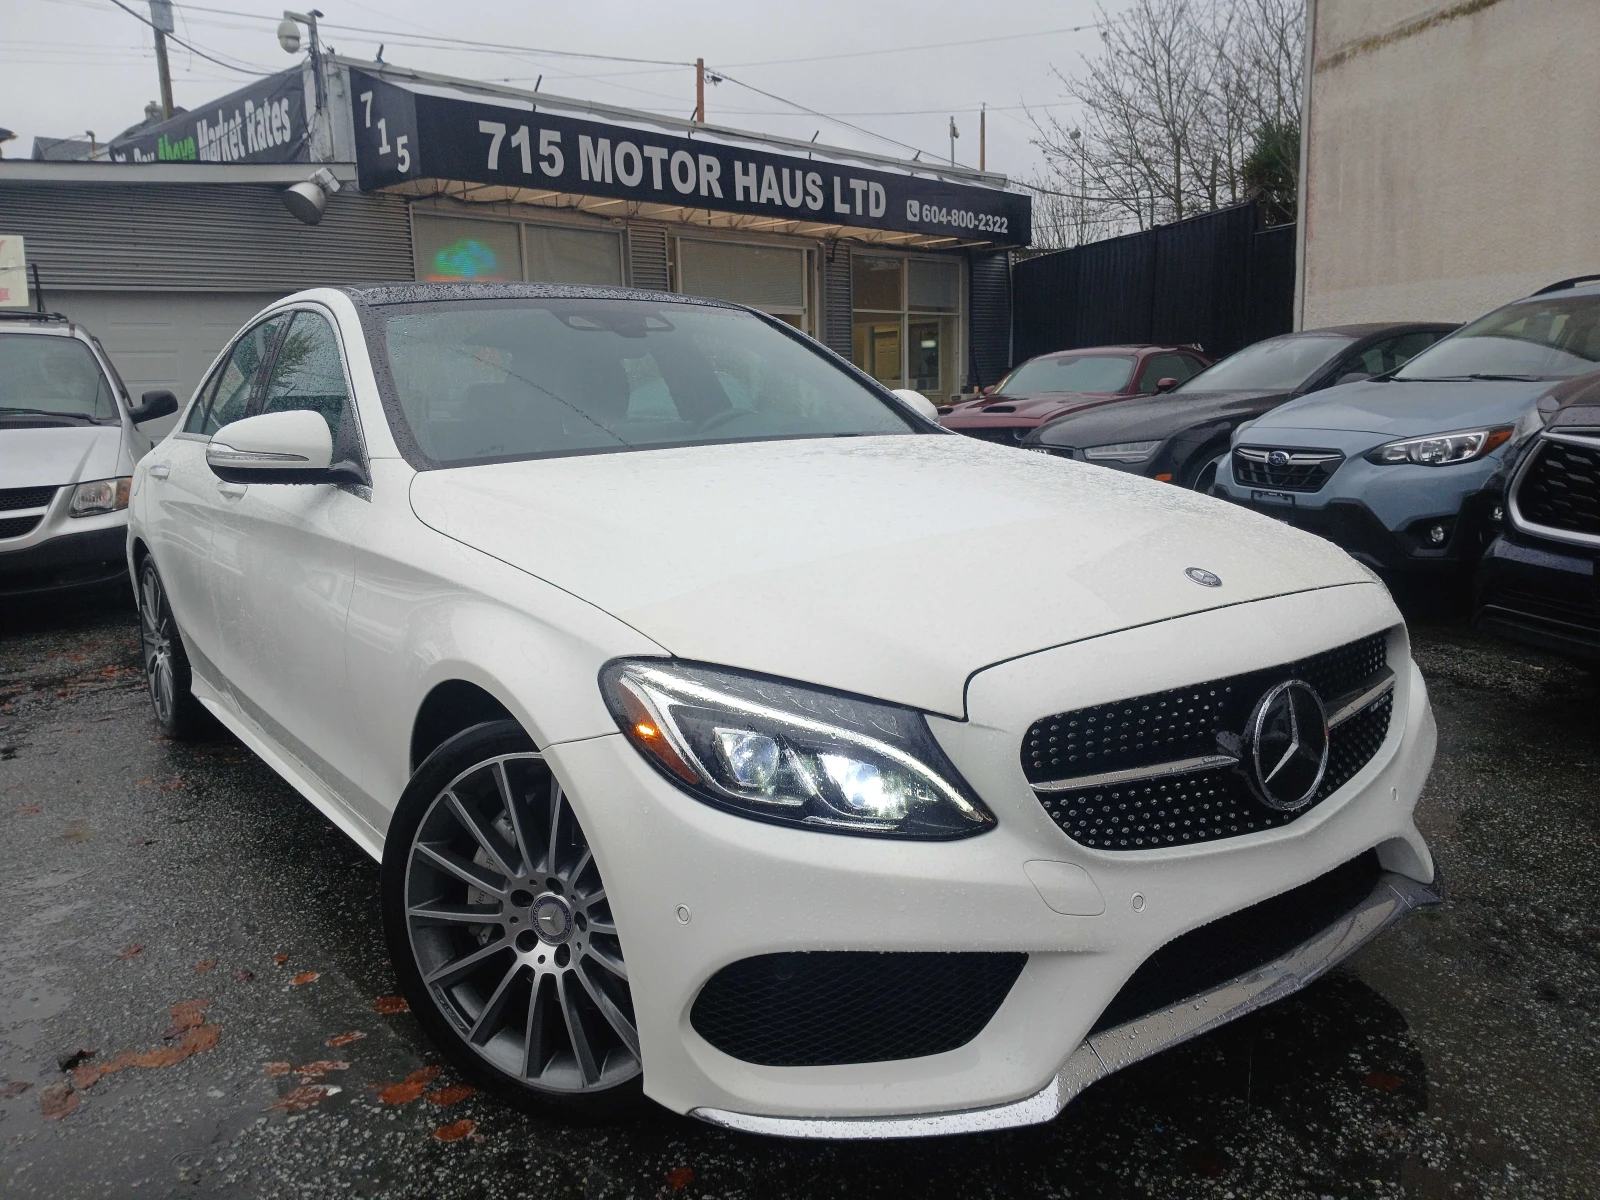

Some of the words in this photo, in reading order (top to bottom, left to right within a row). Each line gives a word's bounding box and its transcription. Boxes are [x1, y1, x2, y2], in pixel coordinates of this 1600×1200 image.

[196, 108, 247, 162] Market
[244, 97, 291, 154] Rates
[478, 120, 565, 178] 715
[578, 134, 724, 199] MOTOR
[733, 160, 825, 211] HAUS
[833, 175, 887, 218] LTD
[922, 204, 1009, 234] 604-800-2322
